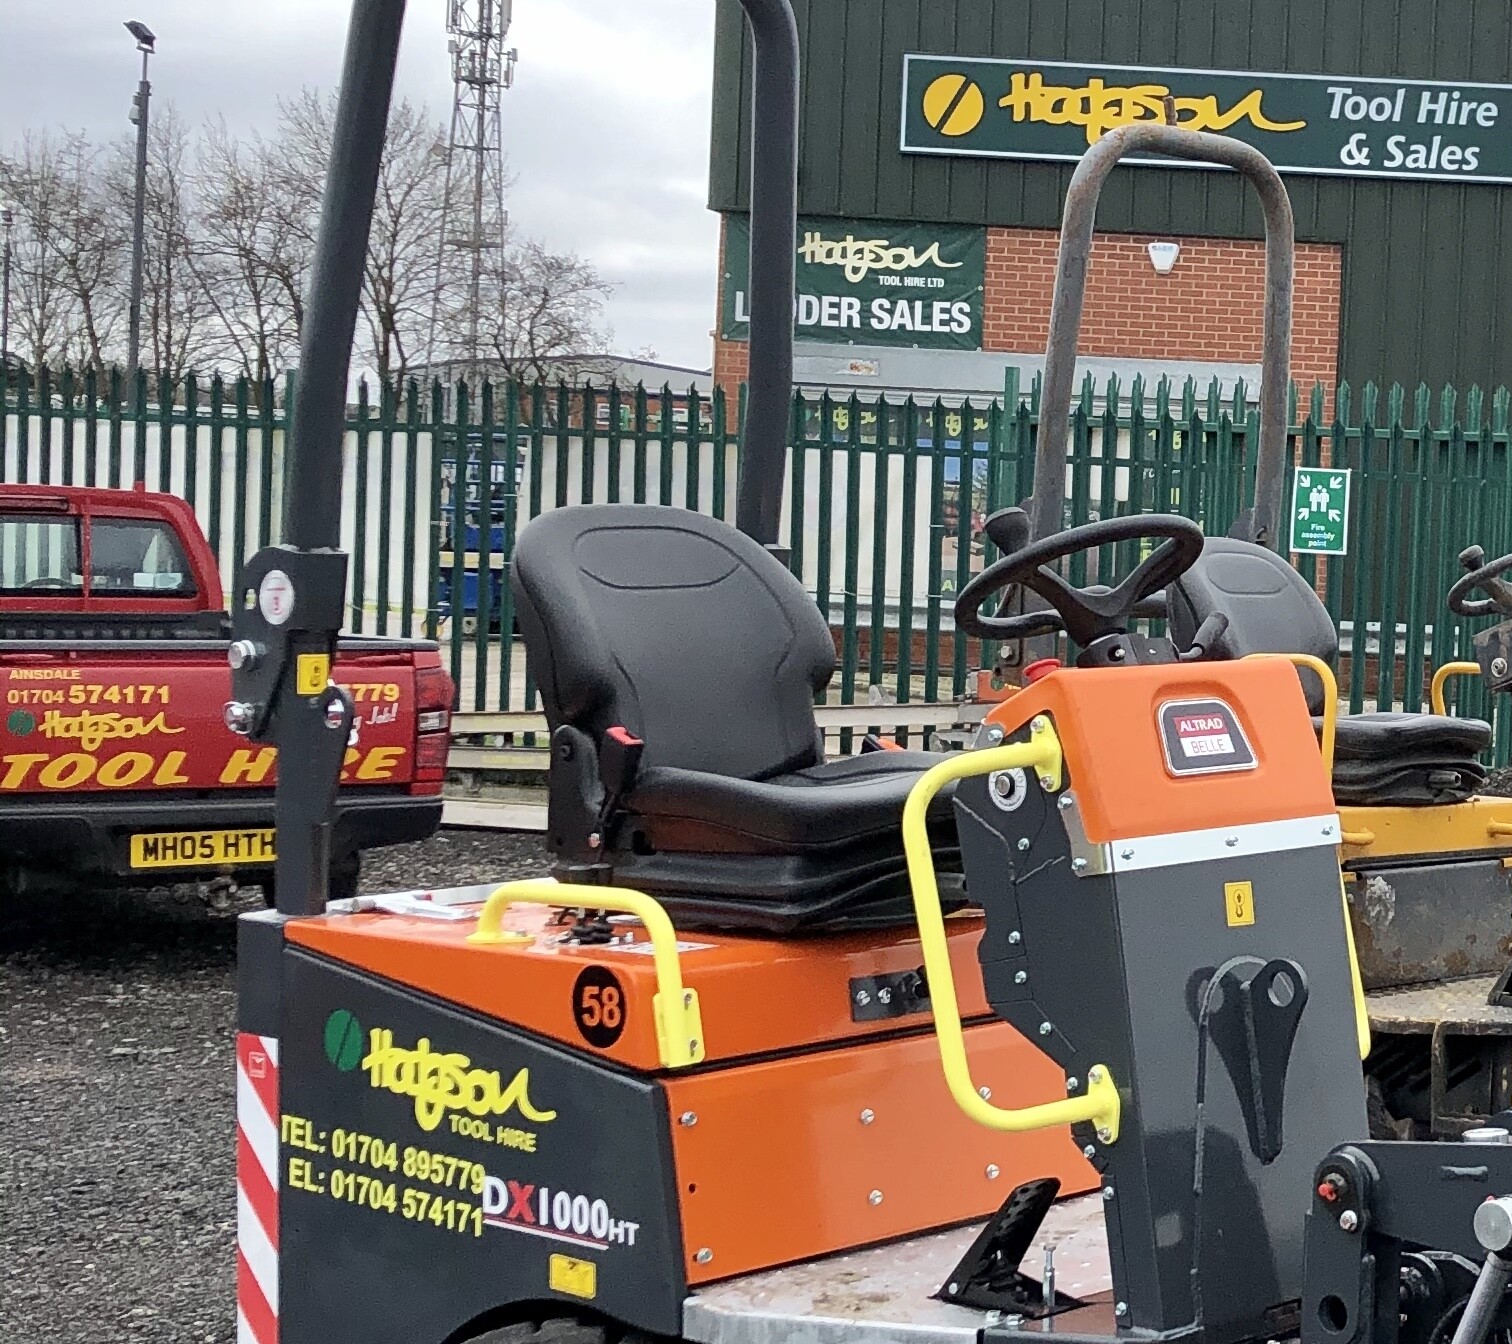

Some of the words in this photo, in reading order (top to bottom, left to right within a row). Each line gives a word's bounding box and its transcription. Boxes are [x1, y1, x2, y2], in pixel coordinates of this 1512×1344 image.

[999, 72, 1307, 144] Hodgson
[1326, 86, 1403, 122] Tool
[1417, 89, 1499, 128] Hire
[1339, 131, 1371, 166] &
[1383, 135, 1481, 172] Sales
[797, 231, 964, 284] Hodgson
[878, 274, 902, 287] TOOL
[903, 275, 926, 288] HIRE
[927, 276, 945, 288] LTD
[735, 290, 861, 329] LDER
[869, 297, 972, 334] SALES
[1300, 531, 1336, 542] assembly
[1310, 523, 1326, 531] Fire
[7, 689, 65, 705] 01704
[68, 684, 170, 704] 574171
[9, 669, 82, 680] AINSDALE
[337, 683, 400, 702] 779
[38, 709, 186, 752] Hodgson
[1179, 717, 1224, 733] ALTRAD
[1190, 738, 1227, 754] BELLE
[1, 750, 189, 789] TOOL
[218, 746, 407, 784] HE
[143, 834, 216, 862] MH05
[581, 985, 621, 1028] 58
[361, 1027, 558, 1132] Hodgson
[449, 1114, 495, 1142] TOOL
[496, 1130, 538, 1153] HIRE
[281, 1114, 327, 1154] TEL:
[331, 1128, 399, 1172] 01704
[402, 1146, 487, 1195] 895779
[330, 1169, 397, 1214] 01704
[402, 1188, 484, 1238] 574171
